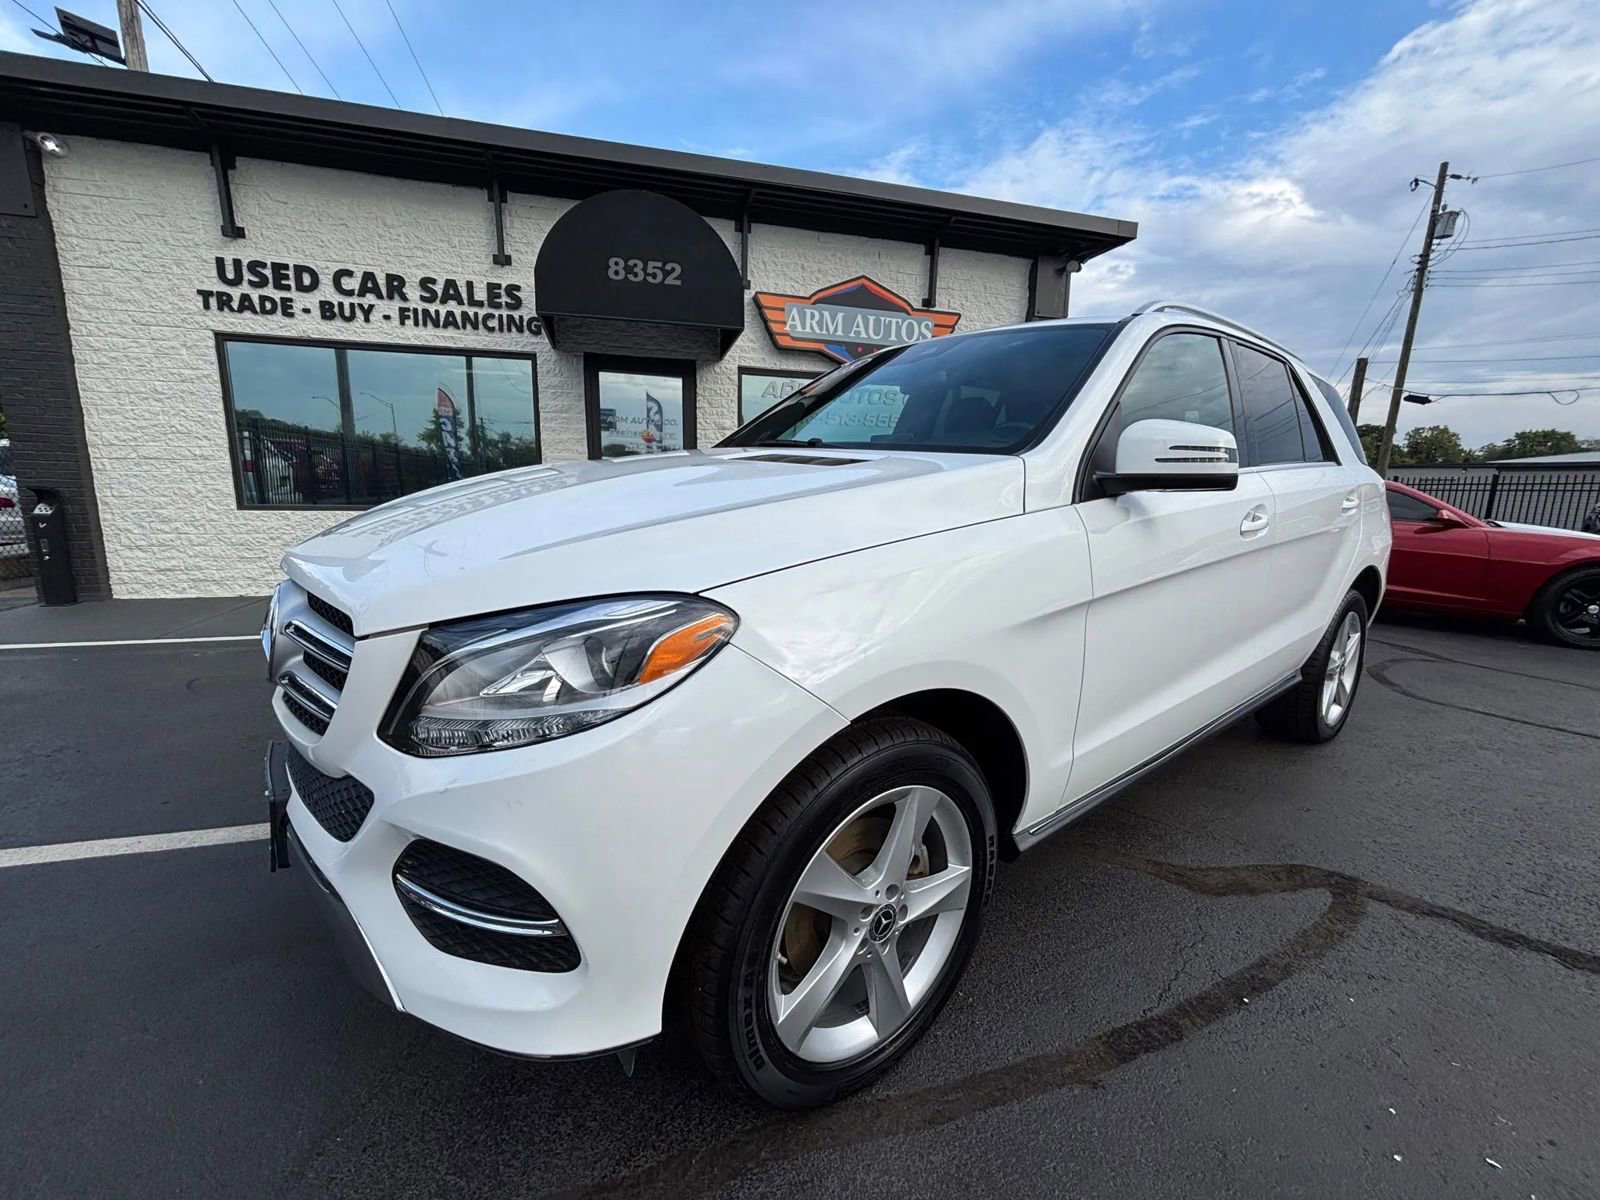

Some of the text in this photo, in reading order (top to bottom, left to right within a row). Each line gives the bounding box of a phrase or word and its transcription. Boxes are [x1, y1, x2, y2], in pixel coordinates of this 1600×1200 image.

[215, 256, 523, 310] USED CAR SALES
[607, 257, 682, 286] 8352
[196, 288, 296, 318] TRADE
[319, 300, 376, 324] BUY
[399, 306, 543, 336] FINANCING
[784, 307, 934, 343] ARM AUTOS
[761, 380, 804, 399] AR
